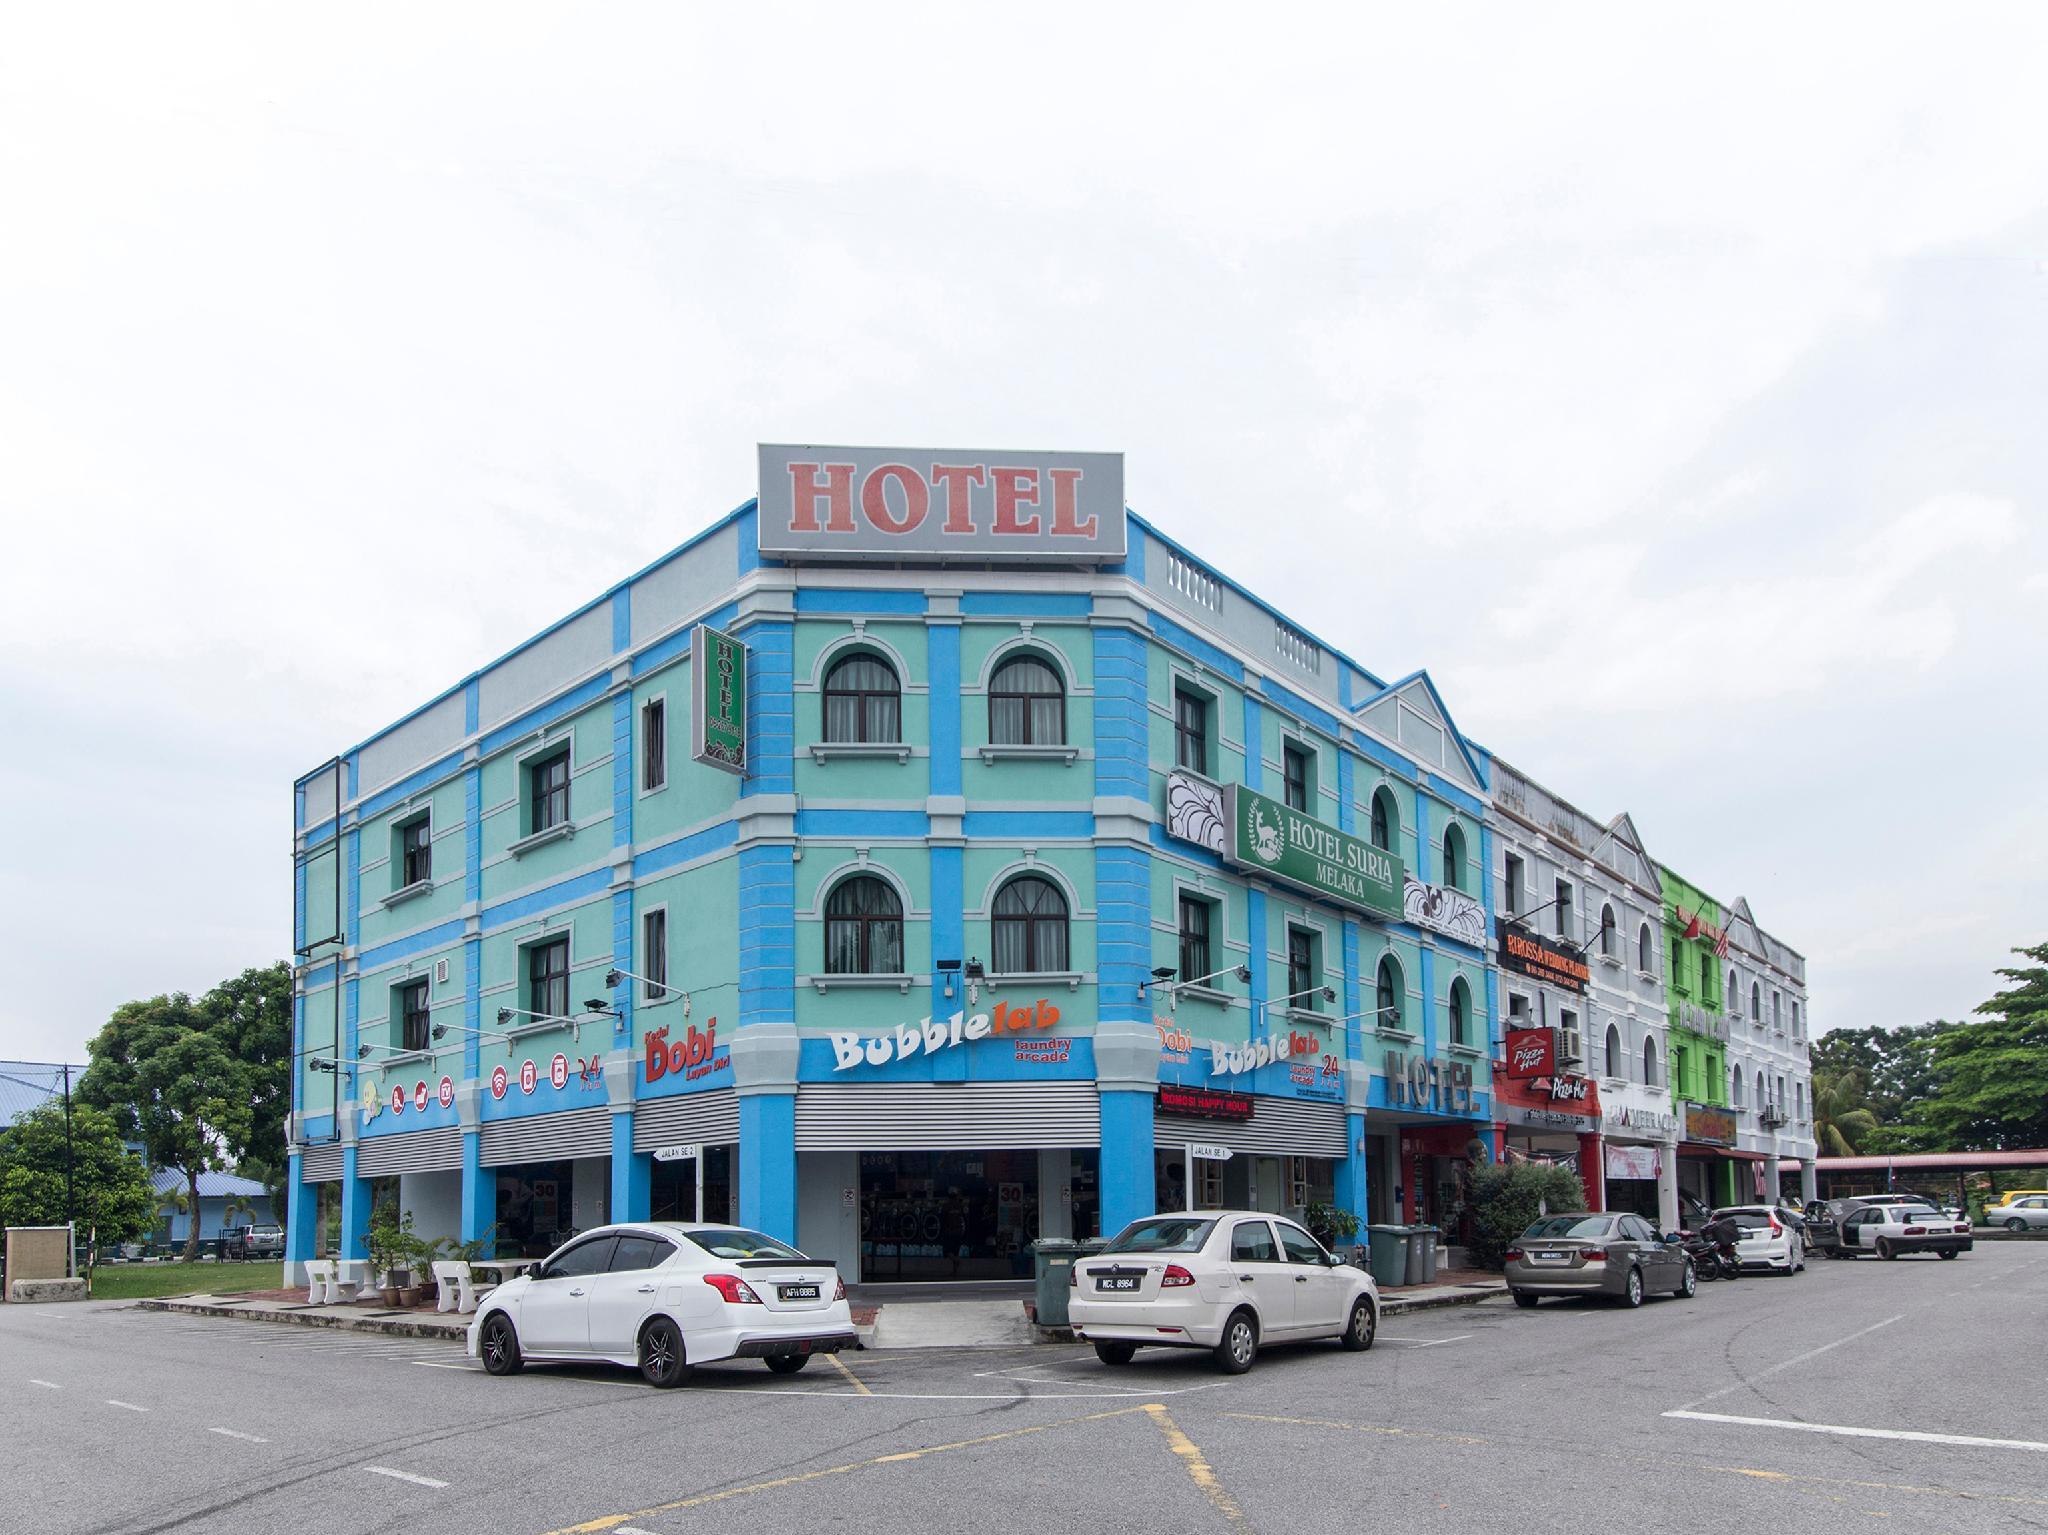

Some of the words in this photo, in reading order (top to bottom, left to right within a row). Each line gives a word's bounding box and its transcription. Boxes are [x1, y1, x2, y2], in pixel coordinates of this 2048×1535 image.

[787, 462, 1098, 540] HOTEL
[717, 640, 734, 721] HOTEL
[1289, 816, 1344, 864] HOTEL
[1348, 843, 1393, 884] SURIA
[1316, 862, 1365, 898] MELAKA
[645, 1017, 717, 1083] Dobi
[1014, 1038, 1072, 1051] laundry
[1513, 1047, 1545, 1064] Pizza
[577, 1054, 601, 1081] 24
[1014, 1050, 1069, 1063] arcade
[1322, 1054, 1339, 1077] 24
[1519, 1056, 1545, 1071] Hut
[1385, 1050, 1480, 1112] HOTEL
[1552, 1077, 1574, 1100] Pizza
[1573, 1080, 1588, 1100] Hut
[1197, 1096, 1226, 1110] HAPPY
[1225, 1099, 1249, 1112] HOUR
[661, 1148, 680, 1158] JALAN
[680, 1146, 689, 1156] SE
[1194, 1146, 1212, 1156] JALAN
[1214, 1148, 1221, 1157] SE
[1001, 1186, 1021, 1201] 30
